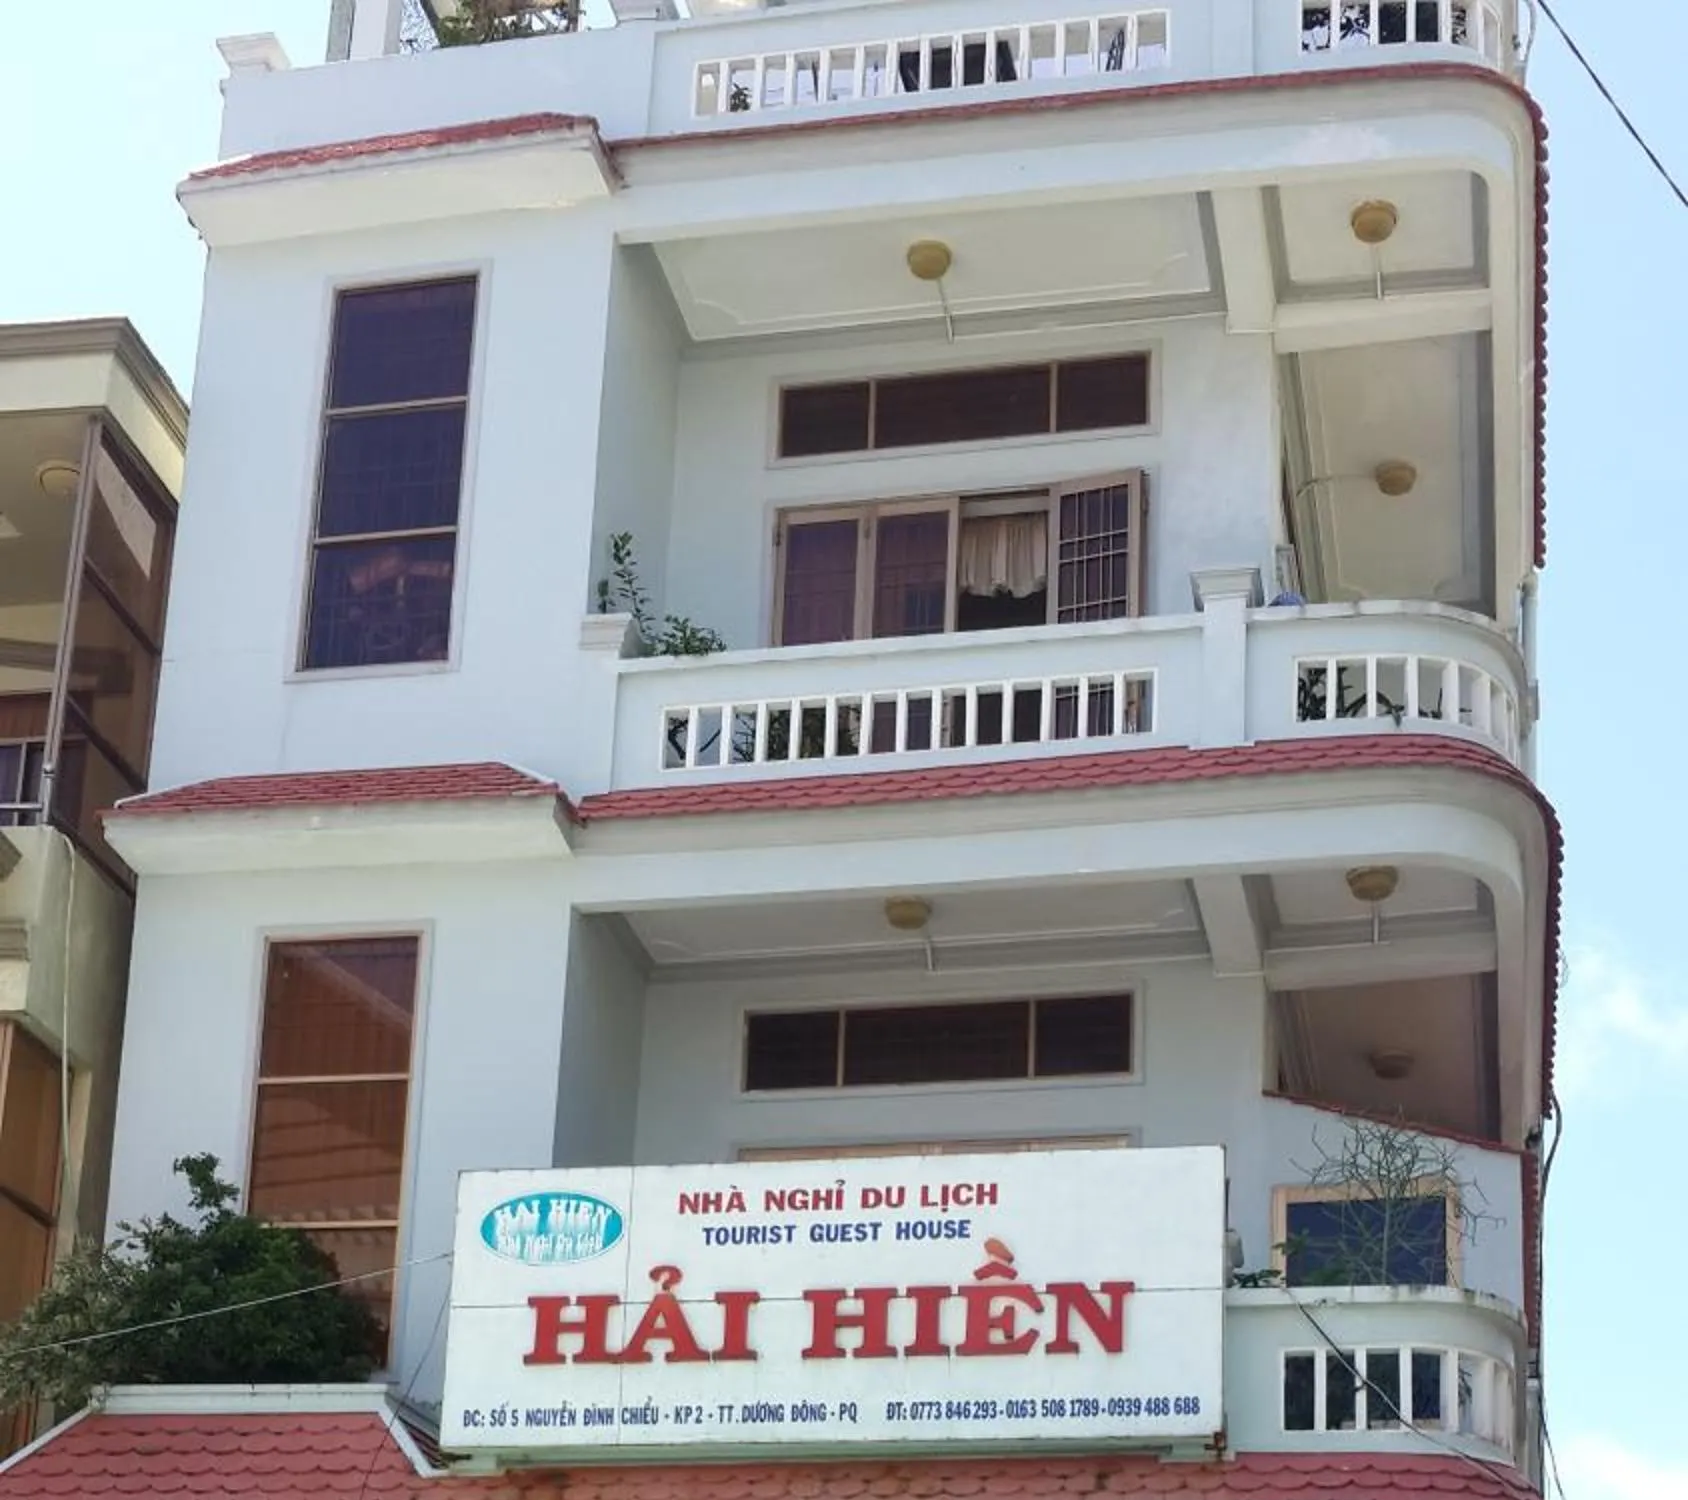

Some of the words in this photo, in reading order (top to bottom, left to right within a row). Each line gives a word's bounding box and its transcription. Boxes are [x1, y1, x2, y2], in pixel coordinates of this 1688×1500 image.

[679, 1184, 747, 1215] NHÀ
[764, 1179, 846, 1212] NGHỈ
[861, 1185, 906, 1209] DU
[920, 1183, 998, 1213] LỊCH
[703, 1224, 796, 1246] TOURIST
[809, 1221, 882, 1243] GUEST
[895, 1219, 971, 1241] HOUSE
[523, 1264, 761, 1366] HẢI
[801, 1237, 1135, 1359] HIỀN
[511, 1408, 519, 1427] 5
[839, 1402, 858, 1424] PQ
[910, 1400, 942, 1421] 0773
[945, 1400, 971, 1421] 846
[1041, 1398, 1067, 1418] 508
[1144, 1396, 1171, 1417] 488
[1173, 1395, 1201, 1416] 688
